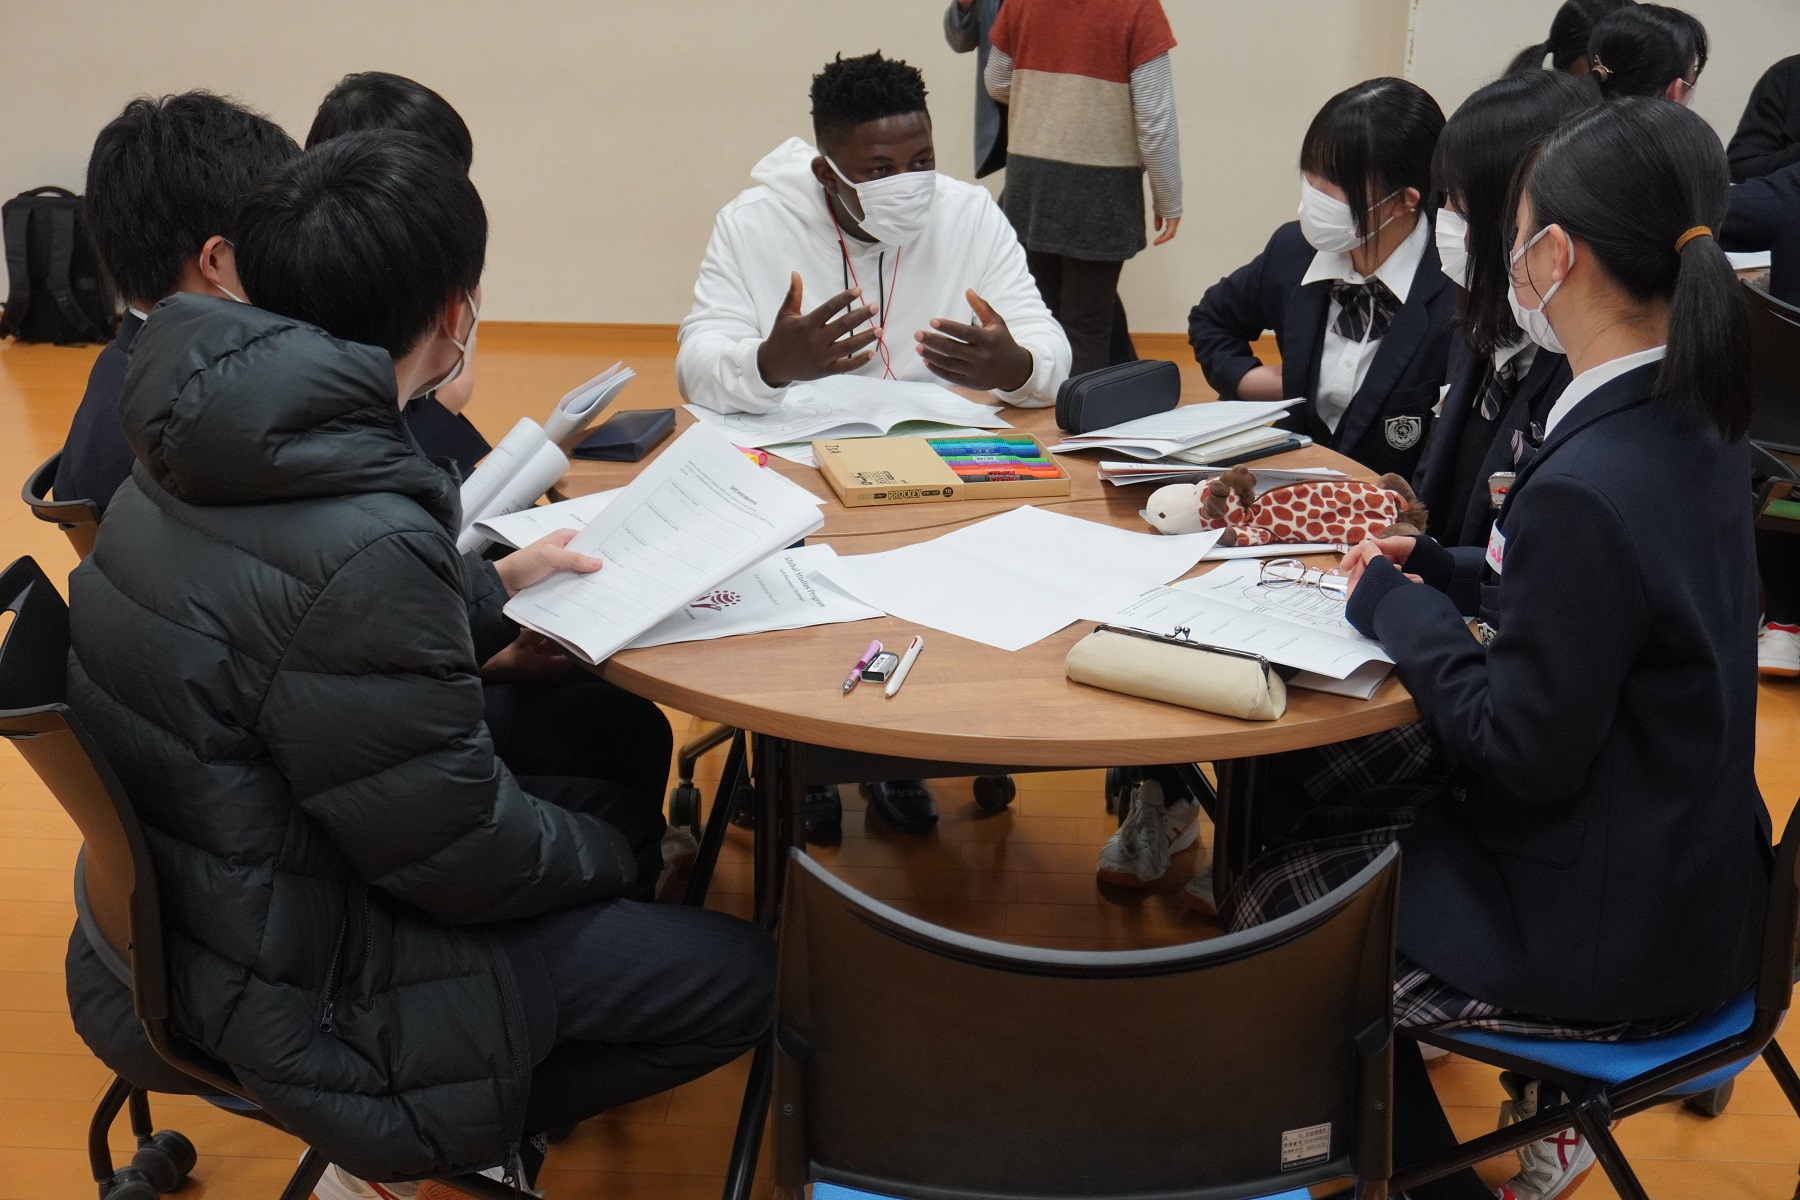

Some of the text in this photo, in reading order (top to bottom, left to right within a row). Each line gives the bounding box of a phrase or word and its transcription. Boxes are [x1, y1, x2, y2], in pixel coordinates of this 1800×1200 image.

[888, 489, 922, 500] PROCKEY
[784, 556, 826, 608] Global Studies Program
